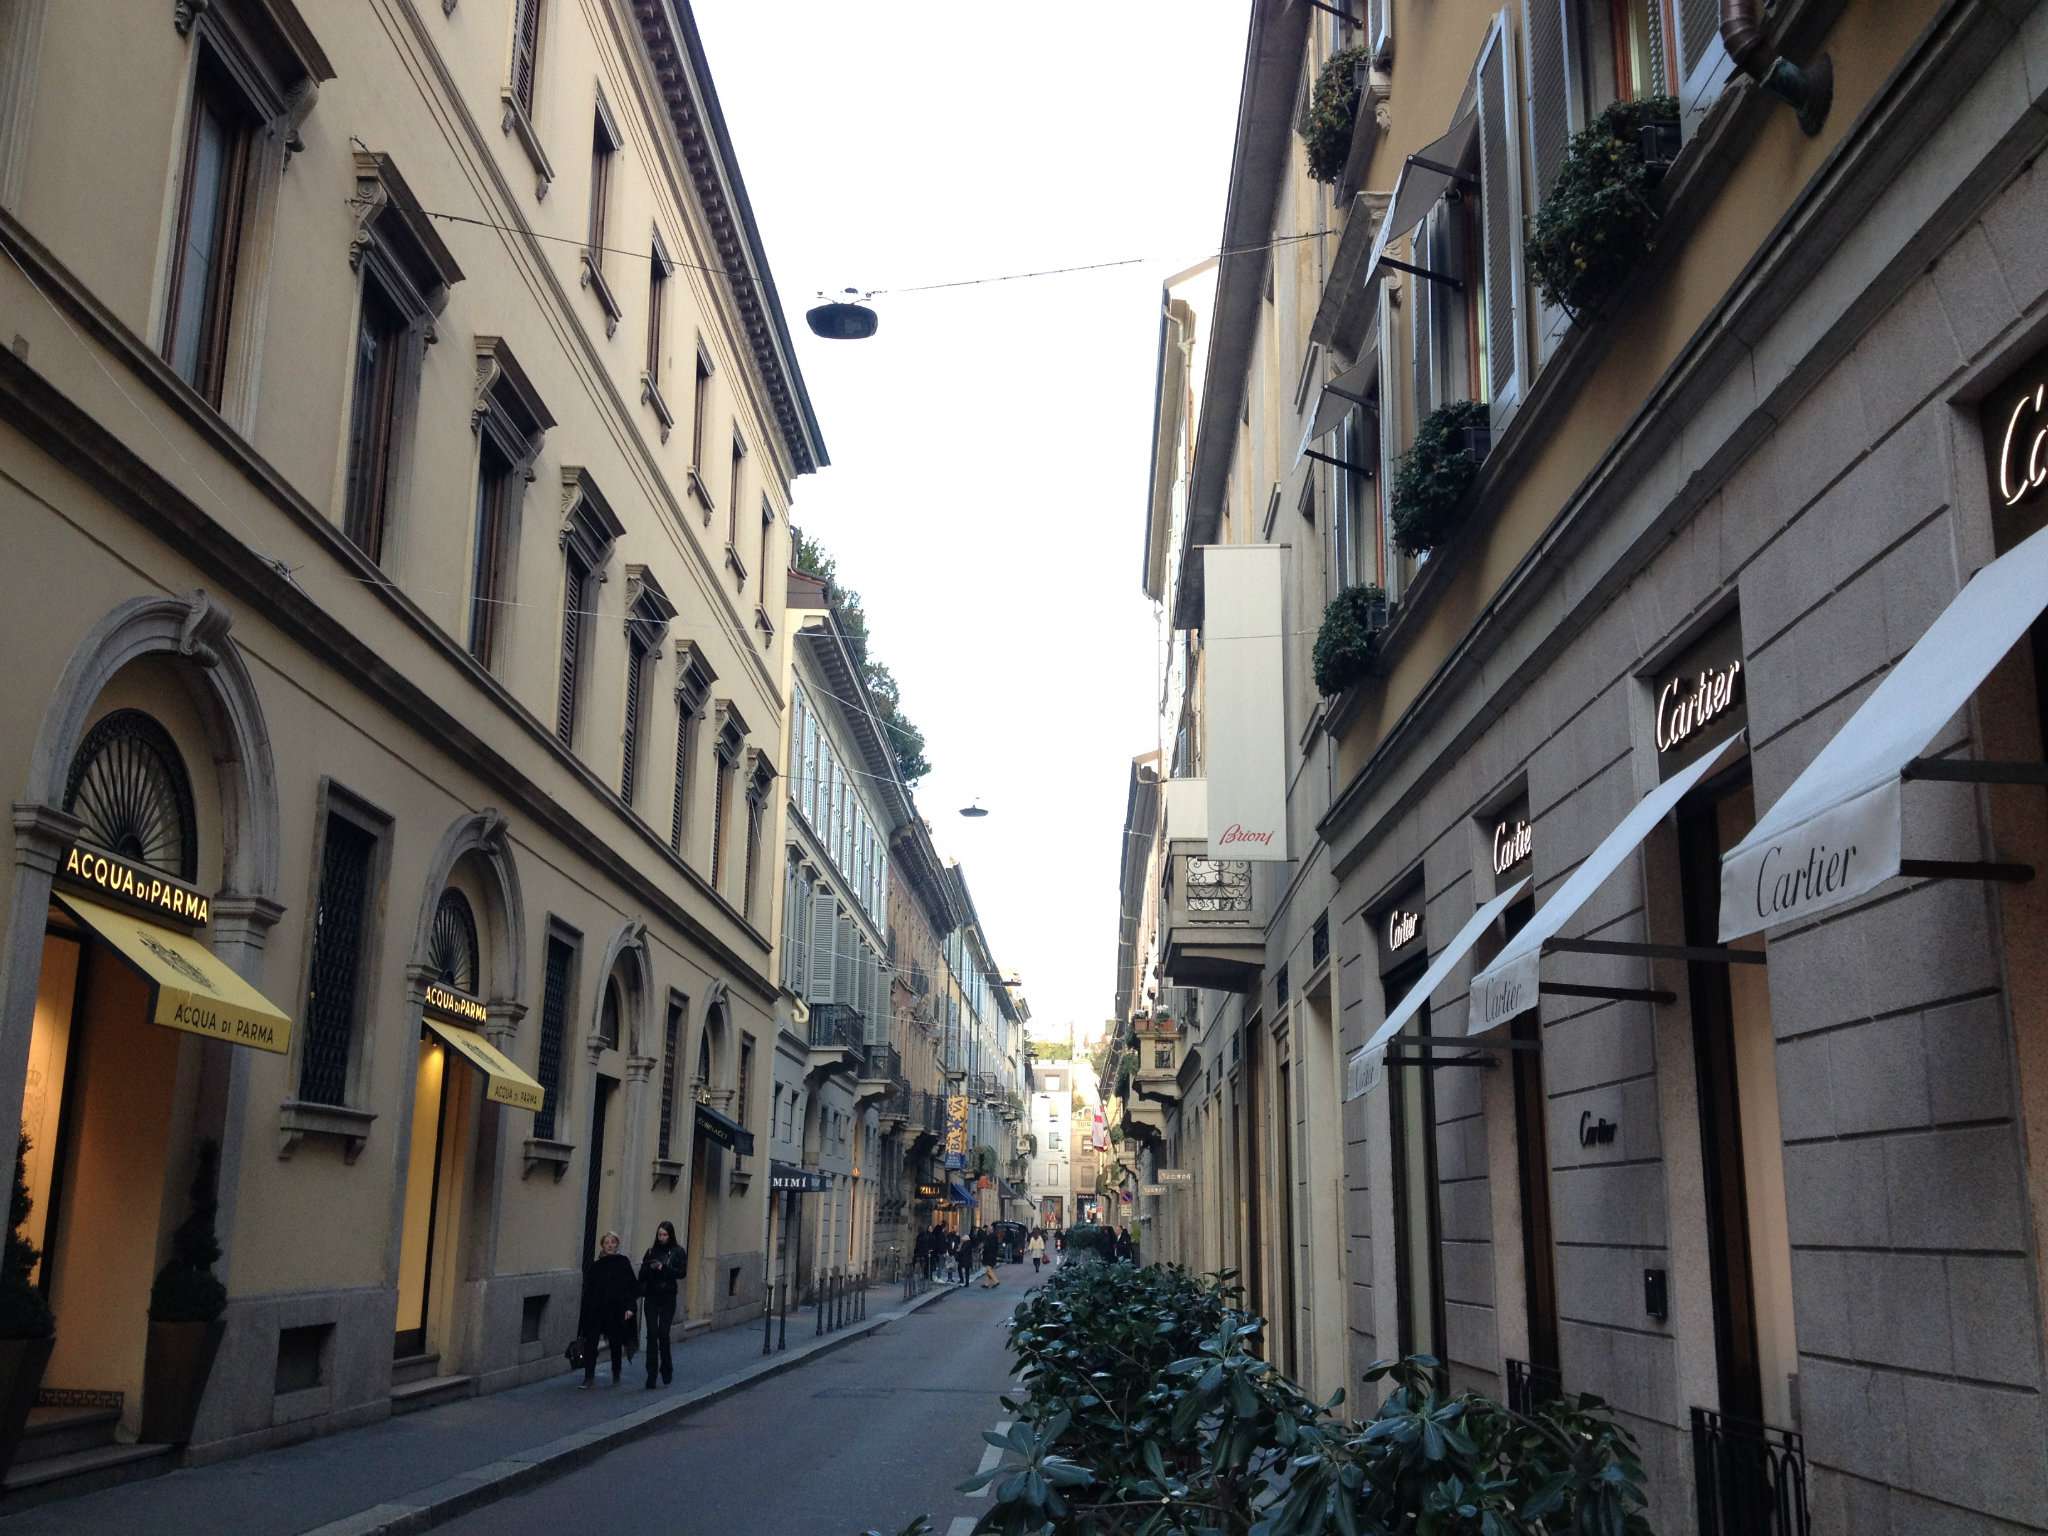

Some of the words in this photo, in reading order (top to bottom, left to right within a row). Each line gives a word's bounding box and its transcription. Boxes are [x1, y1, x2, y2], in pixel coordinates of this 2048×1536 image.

[1657, 660, 1740, 753] Cartier
[1219, 823, 1275, 846] Brioni
[1493, 820, 1532, 875] Cartie
[66, 847, 134, 895] ACQUA
[150, 879, 208, 923] PARMA
[1756, 845, 1857, 918] Cartier
[1389, 910, 1418, 951] Cartier
[425, 985, 454, 1012] ACQUA
[460, 998, 487, 1023] PARMA
[1485, 978, 1523, 1023] Cartier
[174, 1004, 216, 1031] ACQUA
[236, 1021, 274, 1044] PARMA
